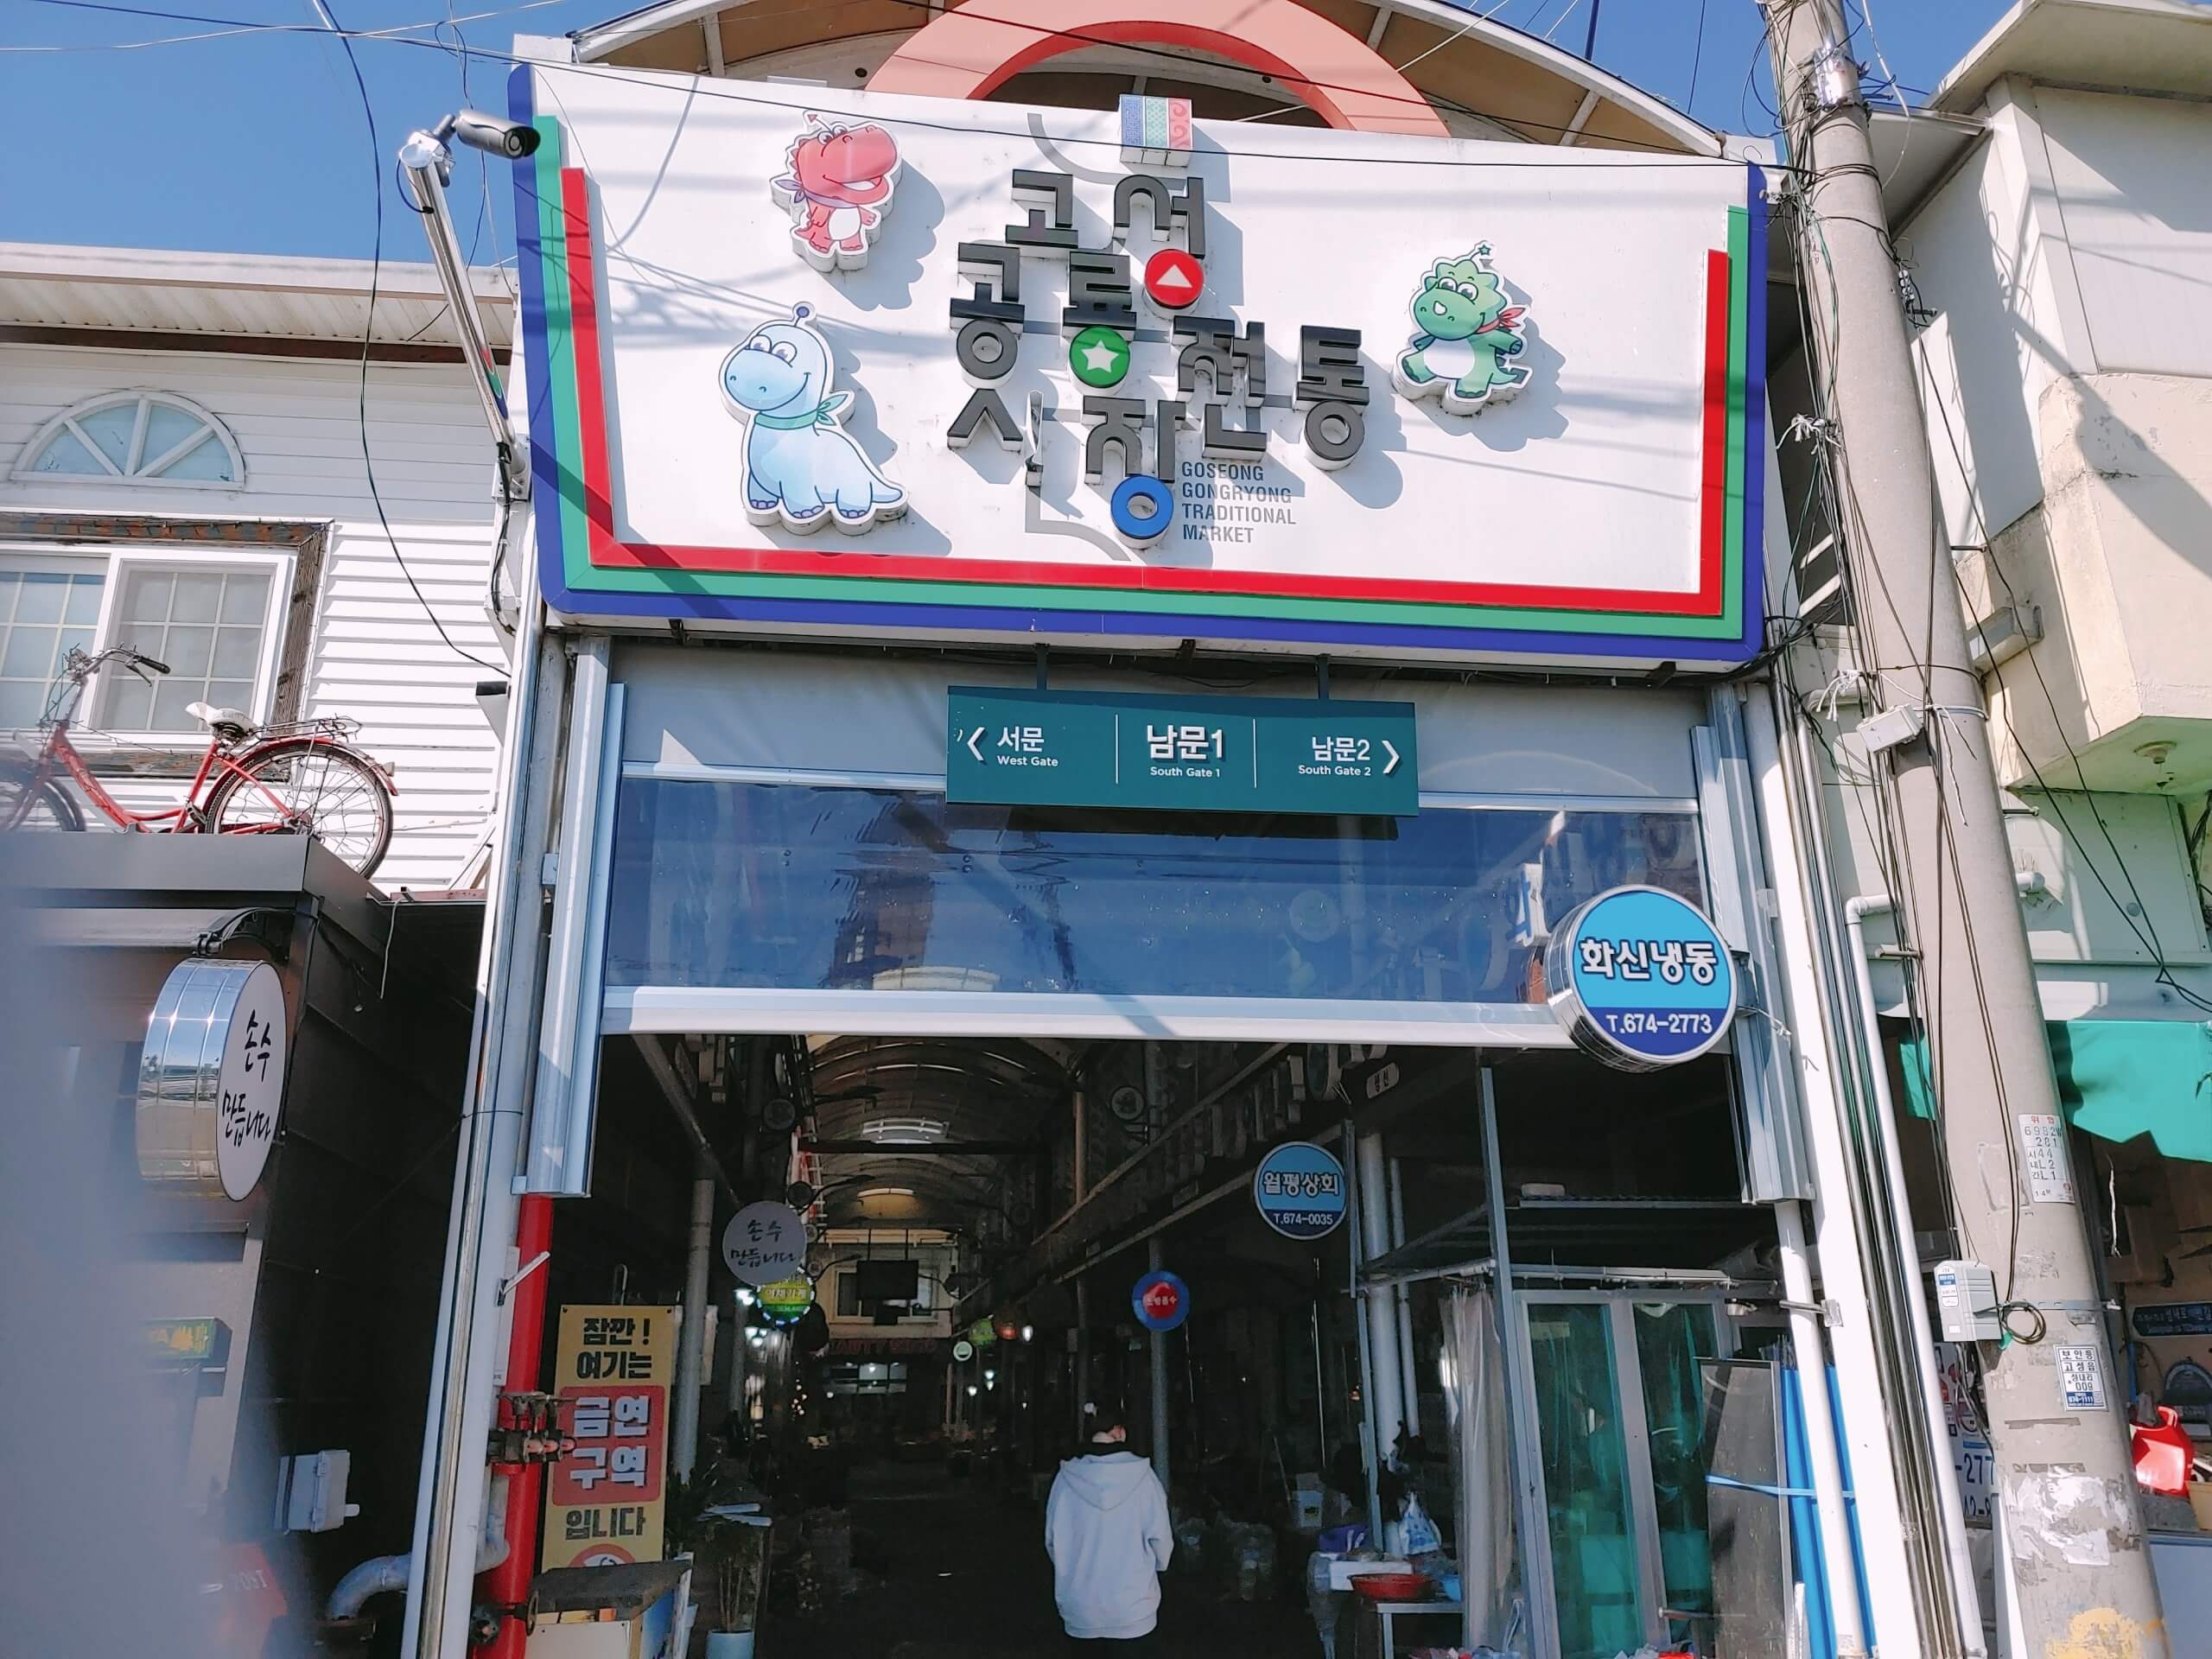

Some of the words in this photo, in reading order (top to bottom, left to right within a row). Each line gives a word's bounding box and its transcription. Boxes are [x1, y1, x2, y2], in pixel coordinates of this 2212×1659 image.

[1181, 461, 1264, 481] GOSEONG
[1182, 482, 1292, 503] GONGRYONG
[1181, 503, 1296, 524] TRADITIONAL
[1183, 524, 1254, 543] MARKET
[996, 727, 1045, 752] 서문
[1146, 724, 1224, 760] 남문1
[1312, 736, 1371, 762] 남문2
[996, 755, 1026, 766] West
[1028, 756, 1058, 767] Gate
[1150, 766, 1183, 778] South
[1185, 767, 1213, 779] Gate
[1215, 768, 1221, 779] 1
[1298, 765, 1332, 777] South
[1334, 766, 1362, 777] Gate
[1363, 766, 1372, 777] 2
[1579, 937, 1719, 985] 화신냉동
[1605, 1014, 1713, 1034] T.674-2773
[245, 1008, 271, 1083] 손수
[221, 1089, 272, 1148] 만듭니다
[1262, 1171, 1339, 1198] 월평상회
[747, 1219, 782, 1243] 손수
[1273, 1212, 1333, 1226] T.674-0035
[730, 1248, 797, 1268] 만듭니다
[576, 1351, 652, 1380] 여기는
[574, 1395, 649, 1438] 금연
[570, 1445, 647, 1490] 구역
[564, 1506, 646, 1541] 입니다
